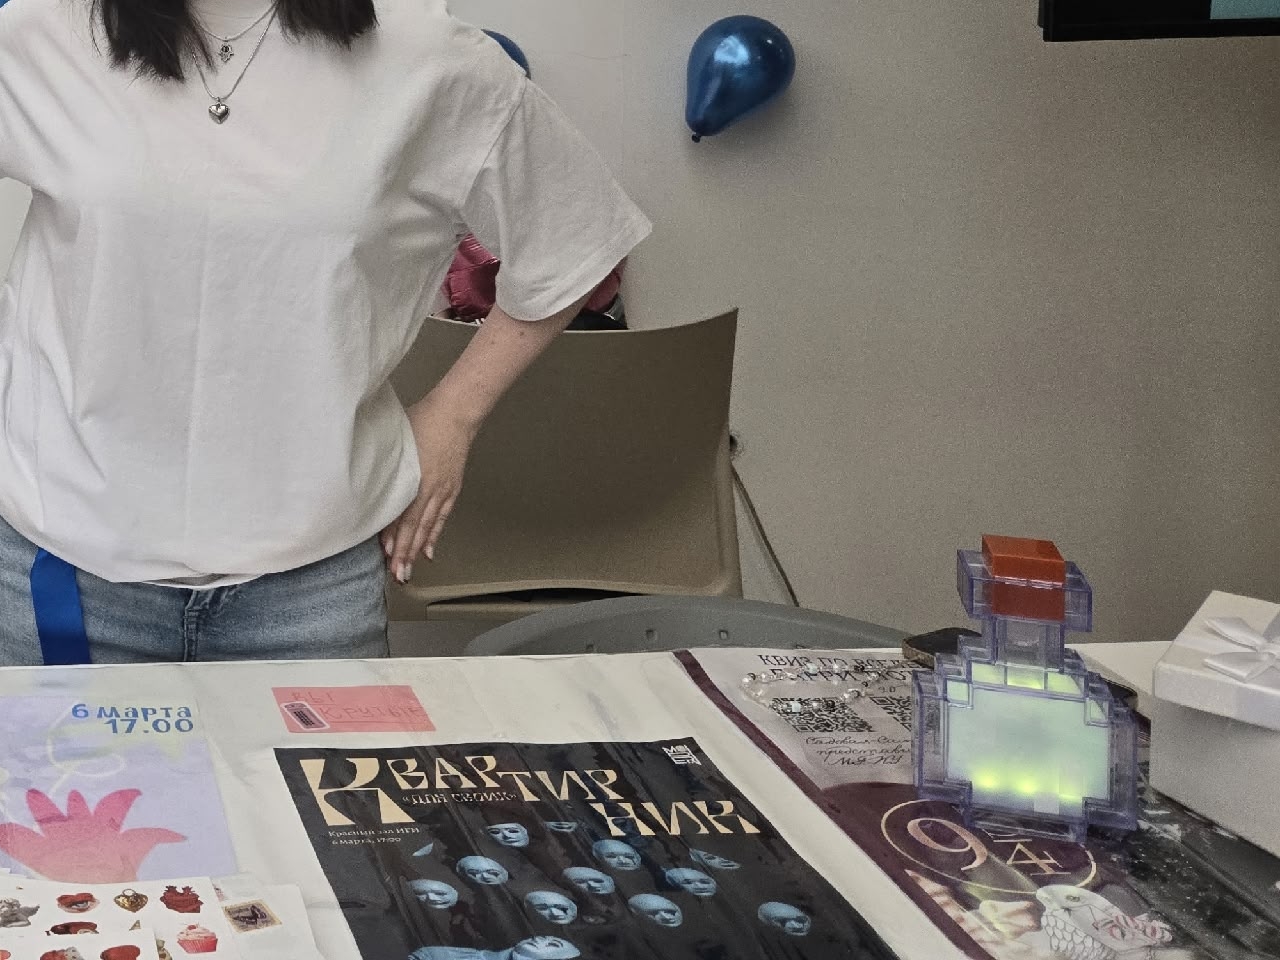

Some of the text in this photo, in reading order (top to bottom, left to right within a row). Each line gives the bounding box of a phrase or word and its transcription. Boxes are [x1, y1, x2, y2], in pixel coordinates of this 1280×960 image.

[72, 703, 192, 722] 6 марта
[104, 718, 194, 734] 17.00
